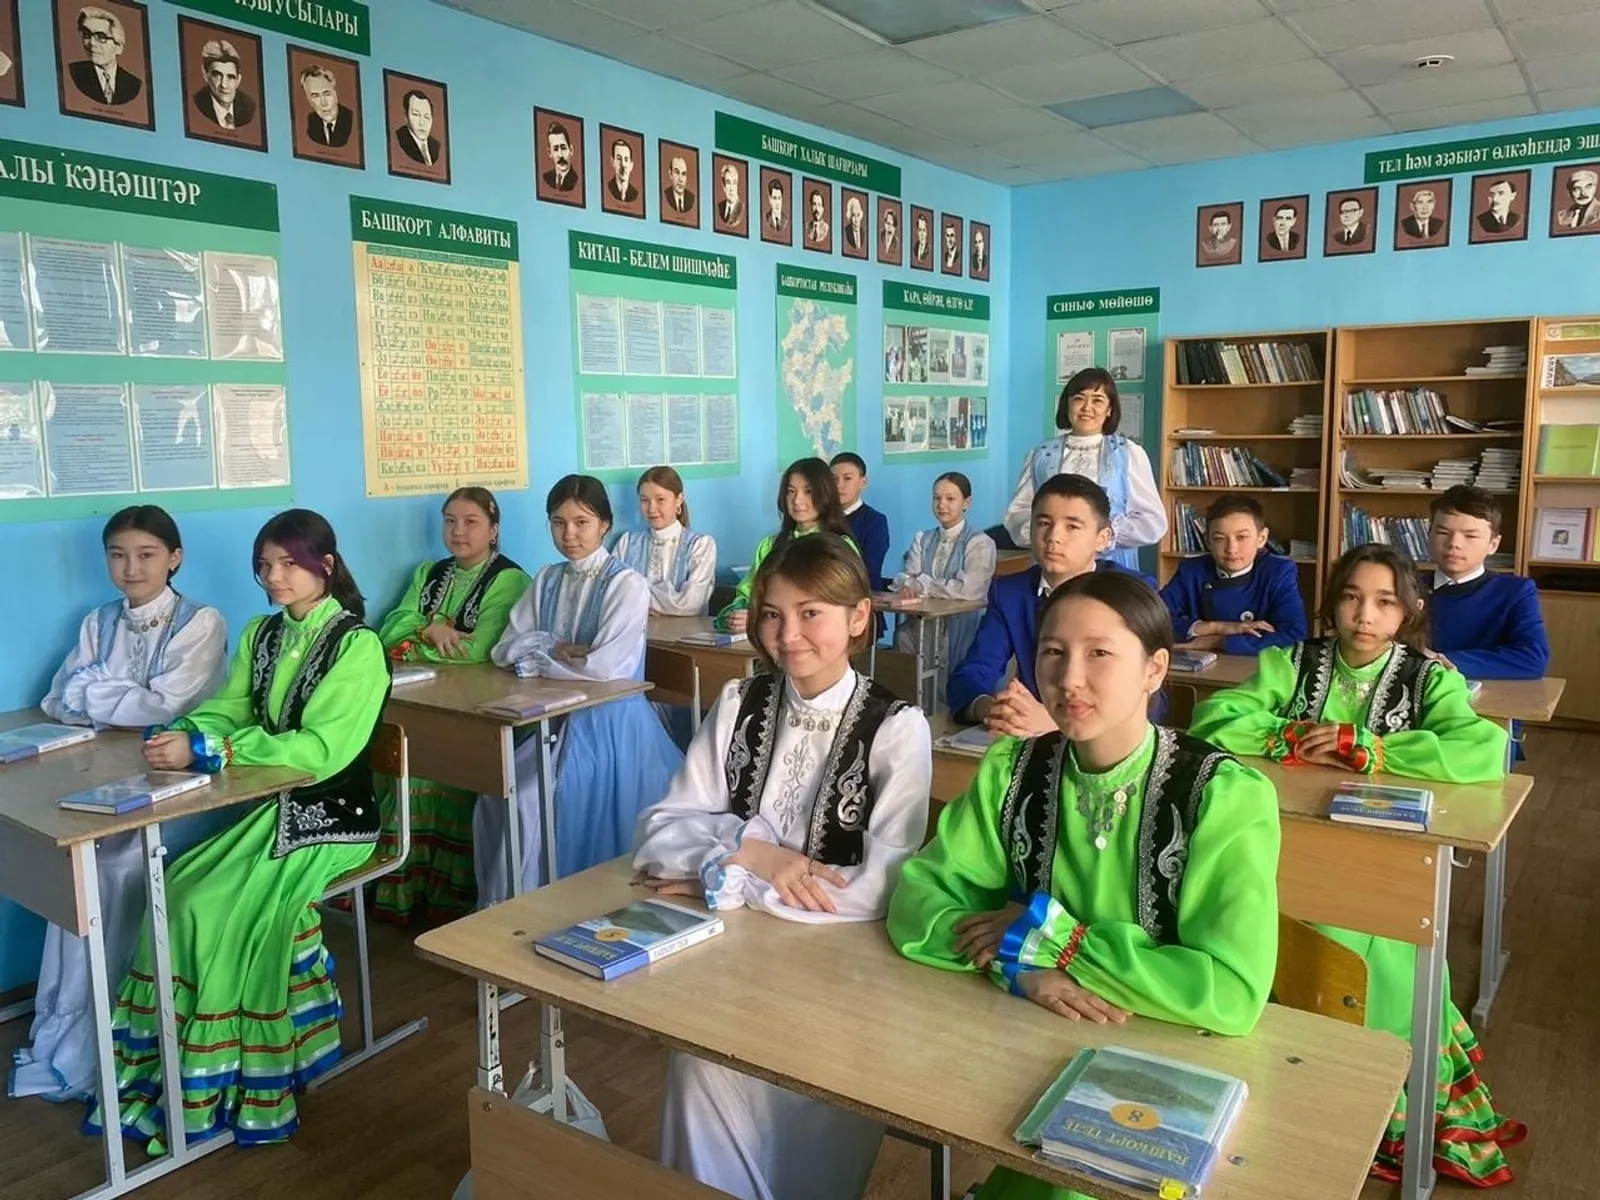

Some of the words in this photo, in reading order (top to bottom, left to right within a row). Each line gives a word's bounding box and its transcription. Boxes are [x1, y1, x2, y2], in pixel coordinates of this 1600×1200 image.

[1378, 159, 1401, 174] ТЕЛ
[1576, 134, 1600, 150] ЭШ
[63, 162, 201, 206] КӘҢӘШТӘР
[438, 223, 511, 248] АЛФАВИТЫ
[578, 241, 621, 264] КИТАП
[629, 249, 670, 271] БЕЛЕМ
[1053, 300, 1095, 313] СИНЫФ
